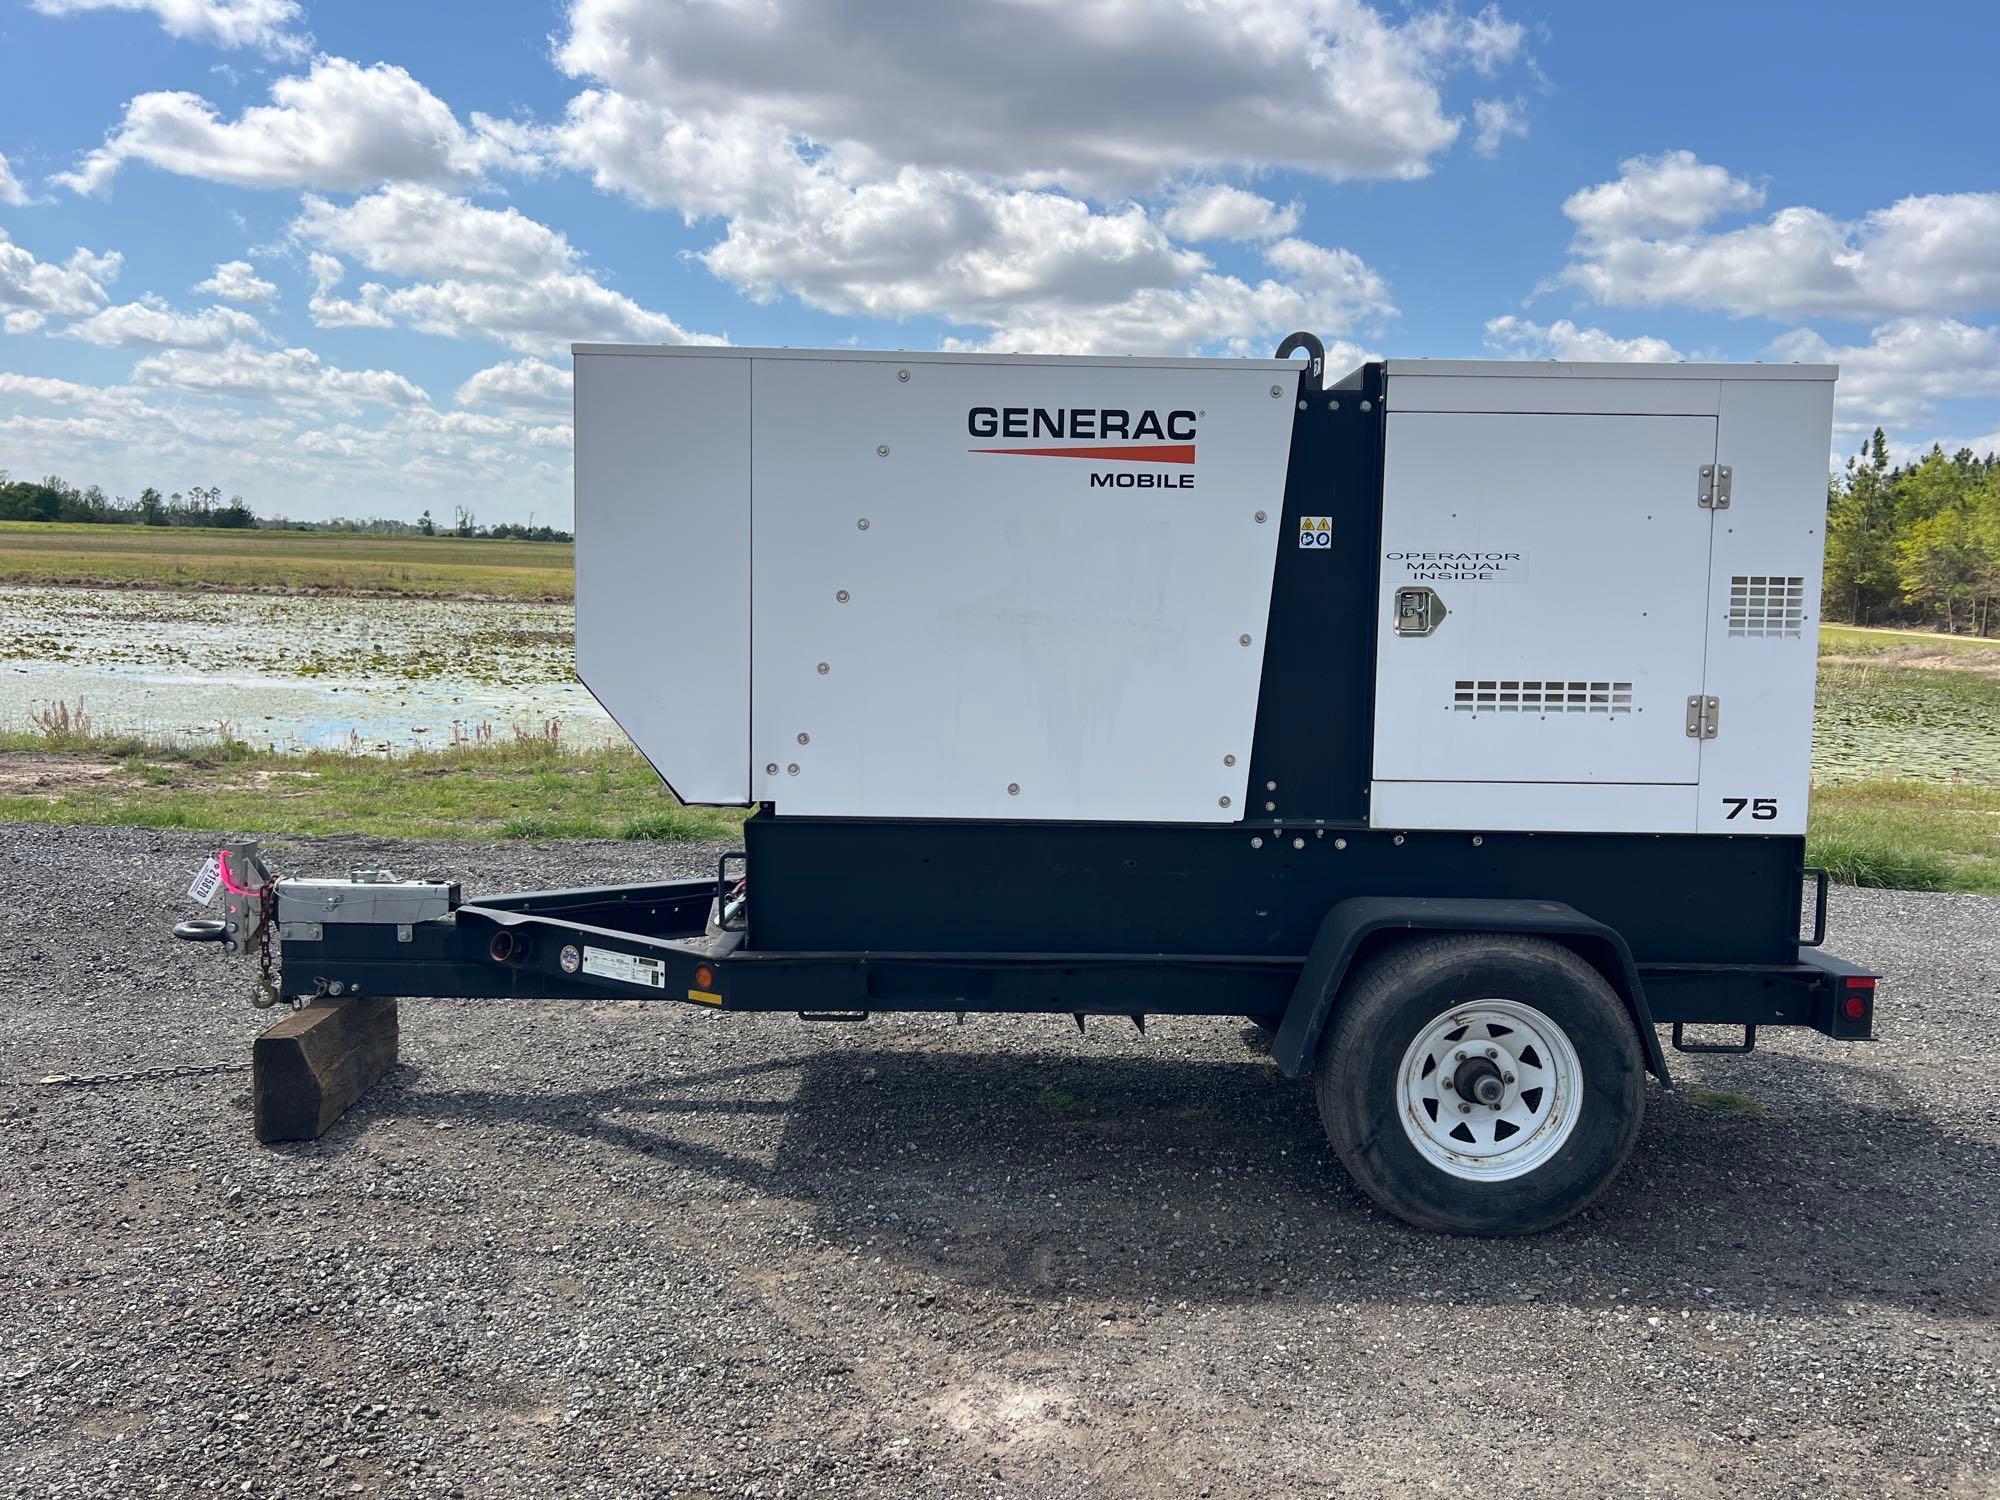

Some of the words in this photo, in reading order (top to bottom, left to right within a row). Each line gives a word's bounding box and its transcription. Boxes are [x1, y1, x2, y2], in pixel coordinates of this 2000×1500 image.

[968, 406, 1197, 441] GENERAC
[1090, 473, 1195, 489] MOBILE
[1386, 552, 1521, 561] OPERATOR
[1406, 562, 1508, 571] MANUAL
[1413, 572, 1493, 580] INSIDE
[1722, 798, 1778, 821] 75
[196, 869, 220, 898] 215870
